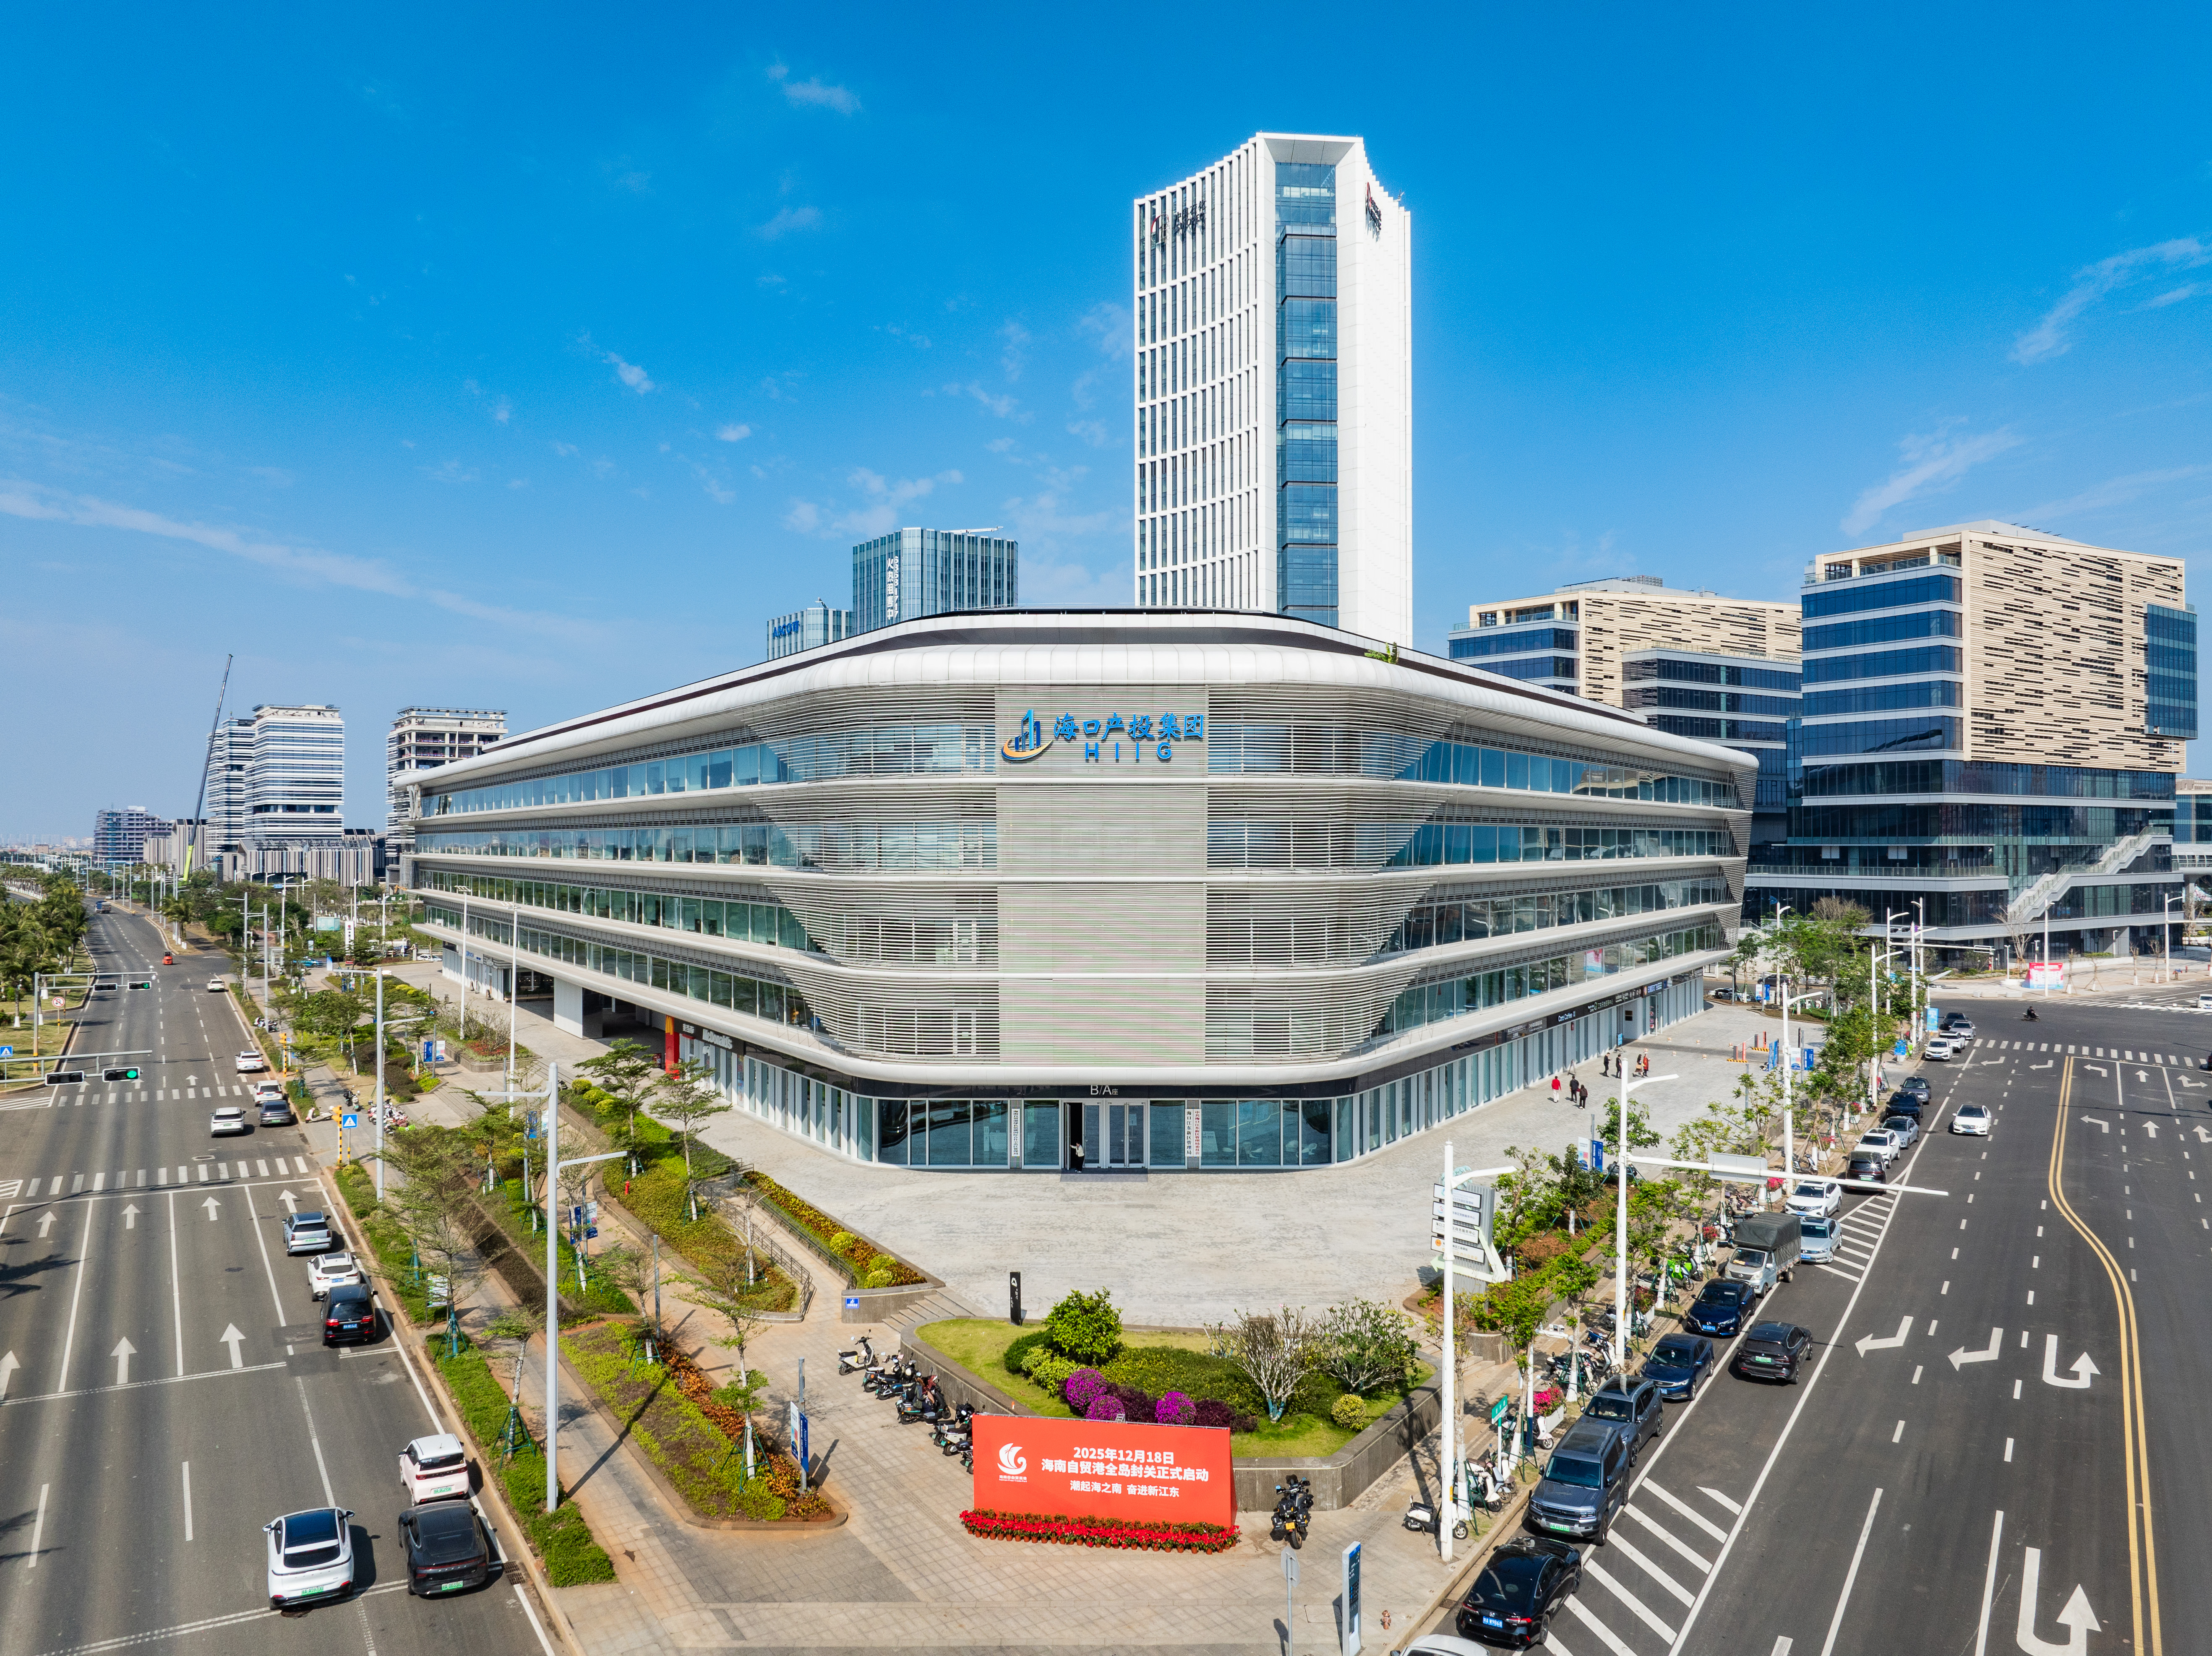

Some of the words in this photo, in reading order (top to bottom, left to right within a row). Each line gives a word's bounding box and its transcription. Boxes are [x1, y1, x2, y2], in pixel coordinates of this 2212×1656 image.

[772, 620, 799, 638] ASCOTT
[1054, 712, 1204, 740] 海口产投集团
[1085, 742, 1172, 759] HIIG
[702, 1028, 733, 1049] McDonald's
[1073, 1447, 1174, 1465] 2025年12月18日
[1041, 1458, 1209, 1482] 海南自贸港全岛封关正式启动
[1070, 1480, 1122, 1494] 潮起海之南
[1127, 1484, 1179, 1497] 奋进新江东
